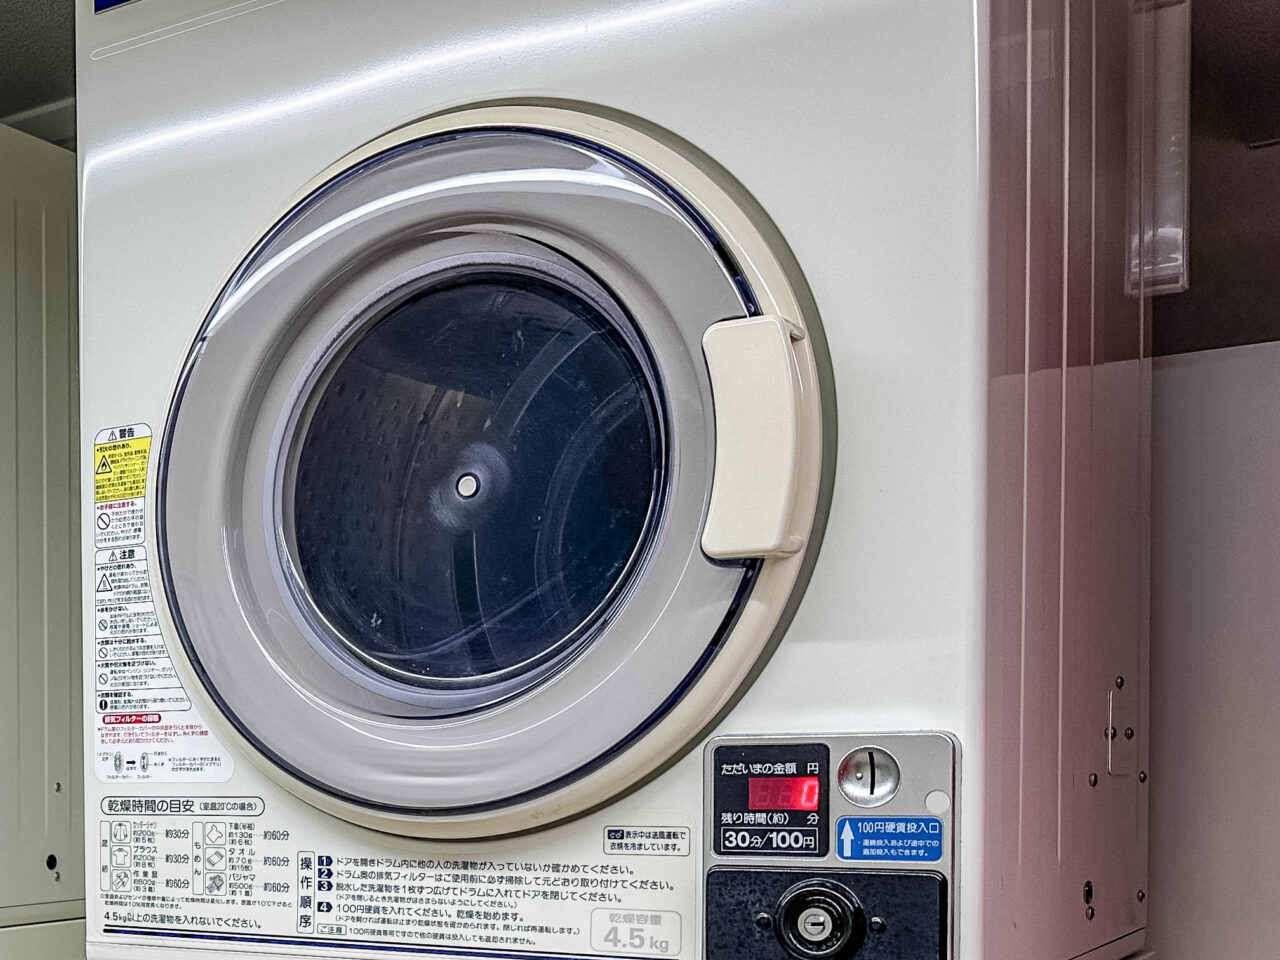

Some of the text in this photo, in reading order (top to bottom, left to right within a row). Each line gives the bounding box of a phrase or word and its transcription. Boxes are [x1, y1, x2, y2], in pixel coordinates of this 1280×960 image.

[118, 428, 135, 439] 警告
[119, 550, 135, 559] 注意
[721, 763, 819, 775] ただいまの金額 円
[108, 799, 195, 813] 乾燥時間の目安
[721, 813, 819, 825] 残り時間(約) 分
[857, 822, 939, 833] 100円硬貨投入口
[165, 829, 190, 839] 約30分
[263, 831, 290, 841] 約60分
[625, 831, 686, 840] 表示中は送風運転で
[724, 831, 815, 849] 30分/100円
[133, 845, 158, 854] ブラウス
[610, 842, 681, 852] 衣類を冷ましています。
[165, 854, 190, 864] 約30分
[263, 857, 290, 867] 約60分
[165, 879, 190, 889] 約60分
[263, 882, 290, 893] 約60分
[608, 912, 662, 926] 乾燥容量
[603, 926, 669, 953] 4.5 kg
